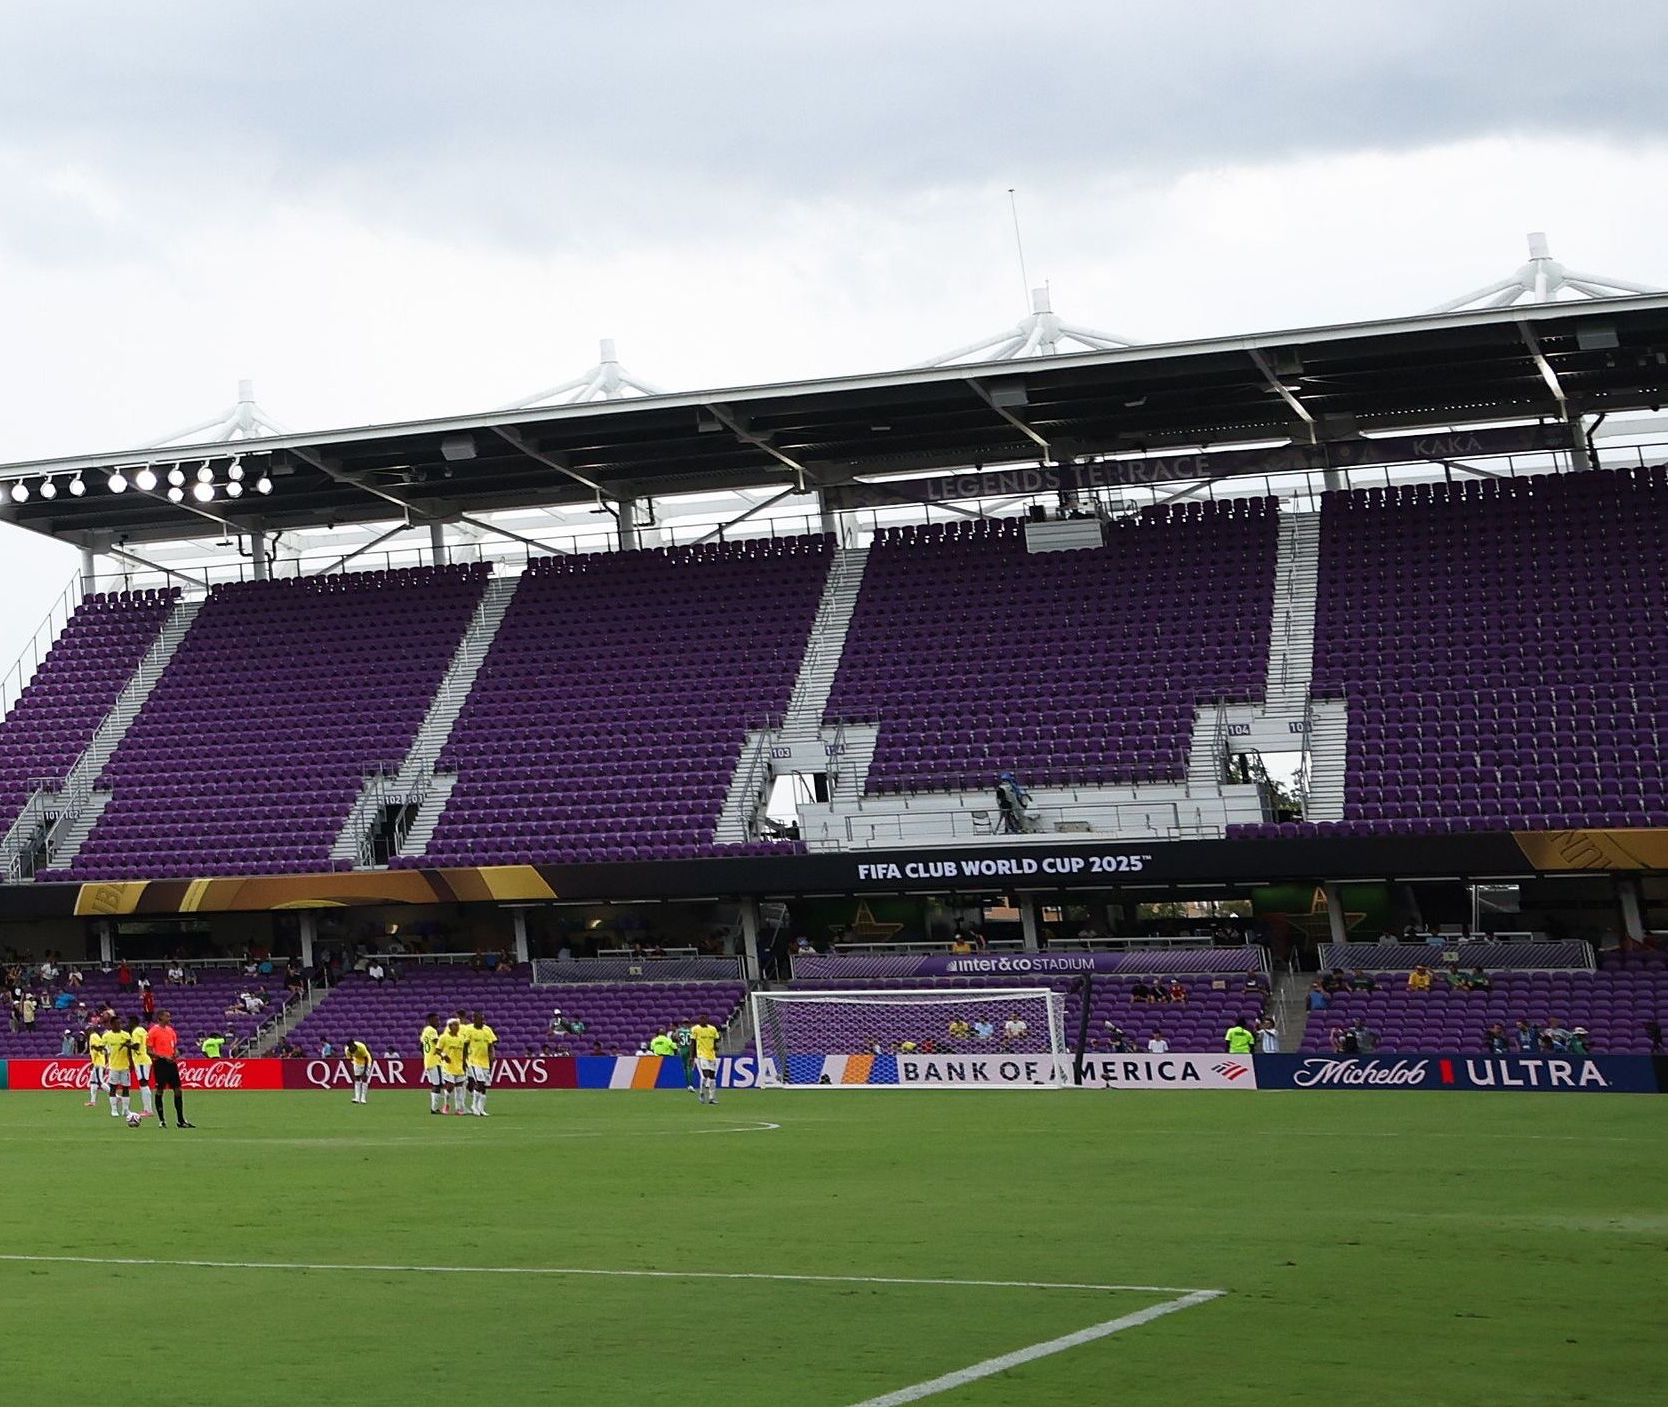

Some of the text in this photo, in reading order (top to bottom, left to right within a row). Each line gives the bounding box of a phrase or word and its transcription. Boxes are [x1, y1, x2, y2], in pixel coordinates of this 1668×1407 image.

[926, 454, 1212, 500] LEGENDS TERRACE
[1228, 724, 1249, 735] 104
[772, 748, 791, 758] 103
[858, 864, 902, 880] FIFA
[904, 861, 958, 878] CLUB
[961, 858, 1038, 876] WORLD
[1042, 856, 1085, 874] CUP
[1032, 958, 1095, 971] STADIUM
[176, 1061, 246, 1088] oca-Cola
[306, 1060, 407, 1089] QAAR
[903, 1061, 991, 1082] BANK
[999, 1061, 1039, 1082] OF
[1294, 1057, 1609, 1087] Michelob ULTRA
